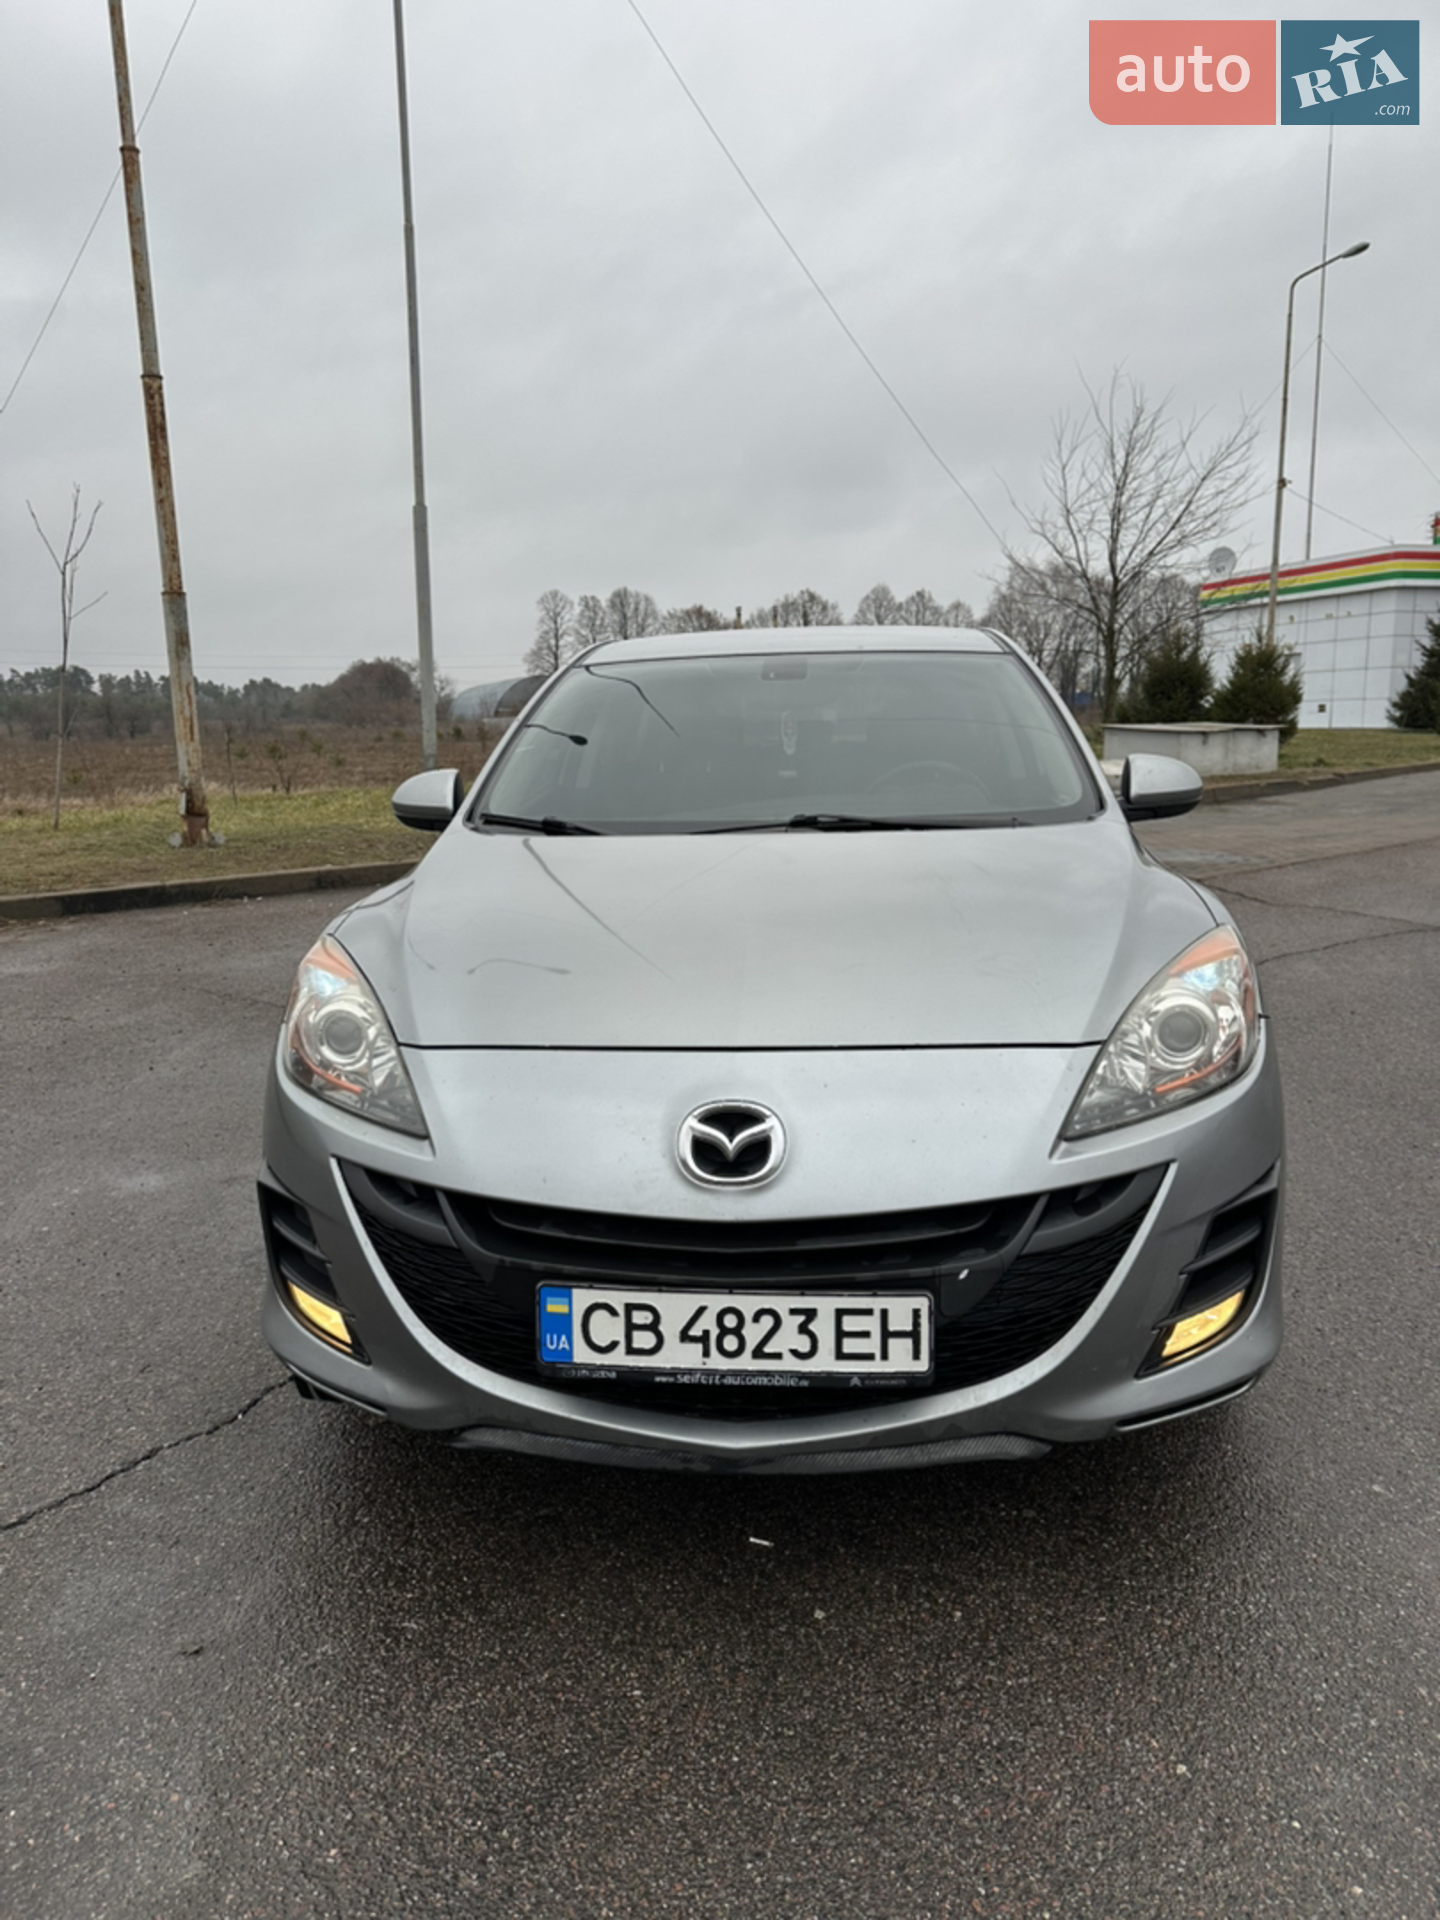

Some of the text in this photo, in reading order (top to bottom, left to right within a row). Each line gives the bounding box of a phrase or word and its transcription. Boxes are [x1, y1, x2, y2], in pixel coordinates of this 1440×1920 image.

[546, 1333, 571, 1351] UA
[580, 1301, 922, 1361] CB 4823 EH
